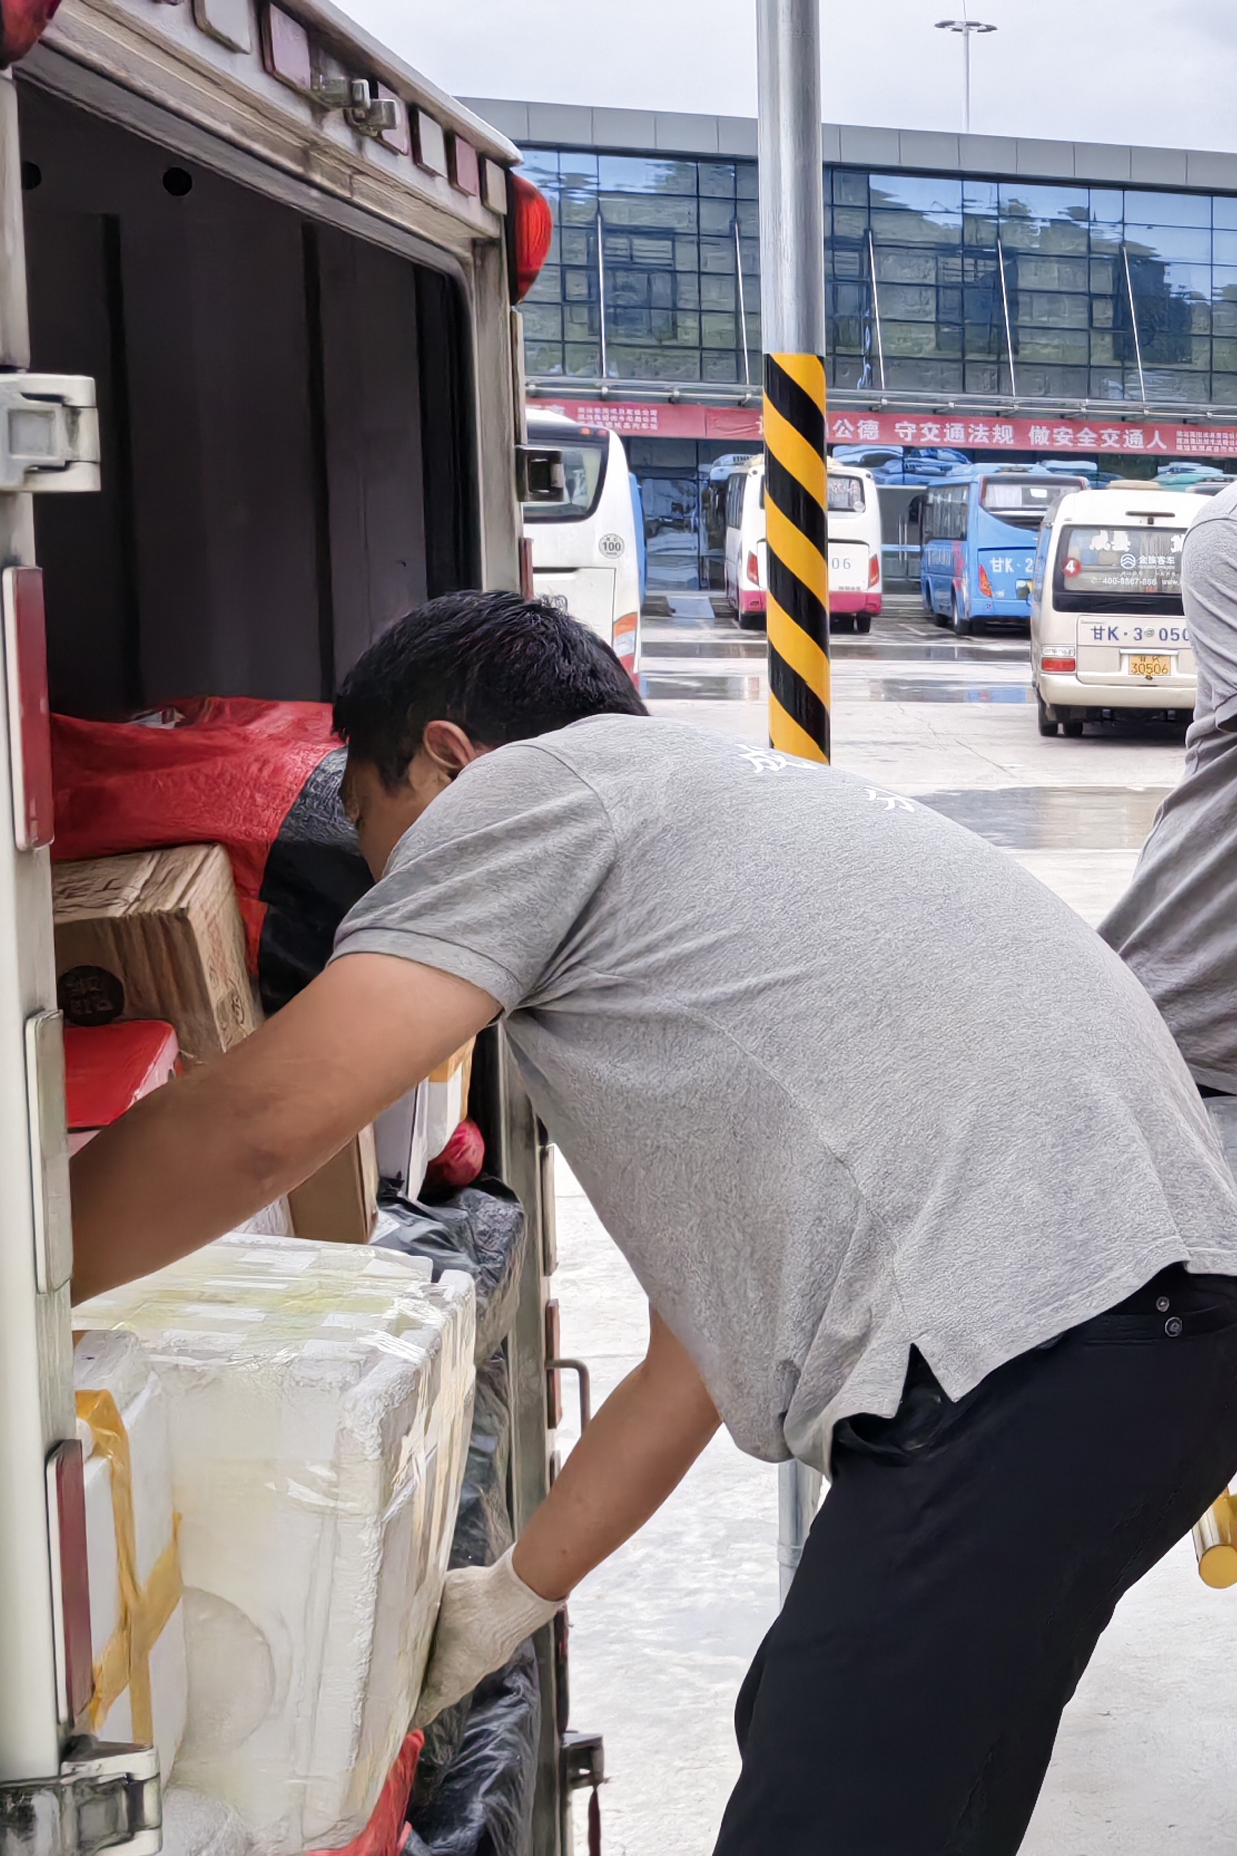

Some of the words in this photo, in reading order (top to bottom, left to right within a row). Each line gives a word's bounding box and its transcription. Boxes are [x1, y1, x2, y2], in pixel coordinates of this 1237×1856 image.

[827, 418, 880, 440] 公德
[894, 423, 1014, 444] 守交通法规
[1029, 426, 1167, 450] 做安全交通人
[602, 541, 622, 552] 100
[1066, 560, 1076, 574] 4
[1131, 663, 1169, 675] 30506
